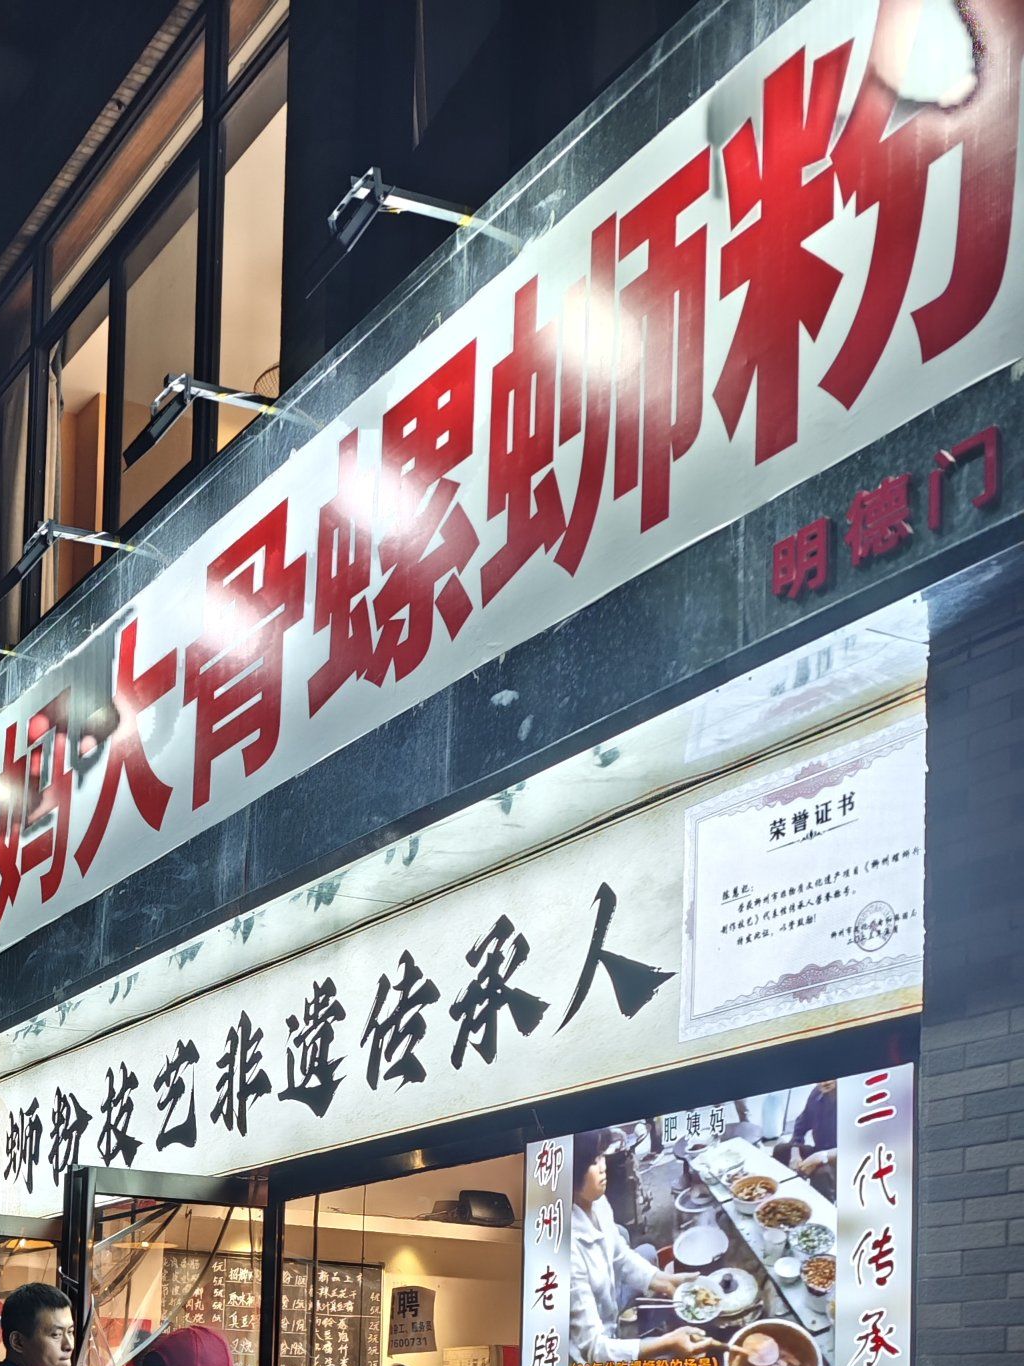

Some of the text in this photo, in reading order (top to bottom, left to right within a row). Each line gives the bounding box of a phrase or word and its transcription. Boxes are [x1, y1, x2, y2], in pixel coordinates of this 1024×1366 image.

[771, 424, 1002, 600] 明德门
[769, 791, 856, 842] 荣誉证书
[663, 1107, 726, 1143] 肥姨妈
[848, 1073, 902, 1366] 三代传承
[317, 1269, 363, 1286] 新品上市
